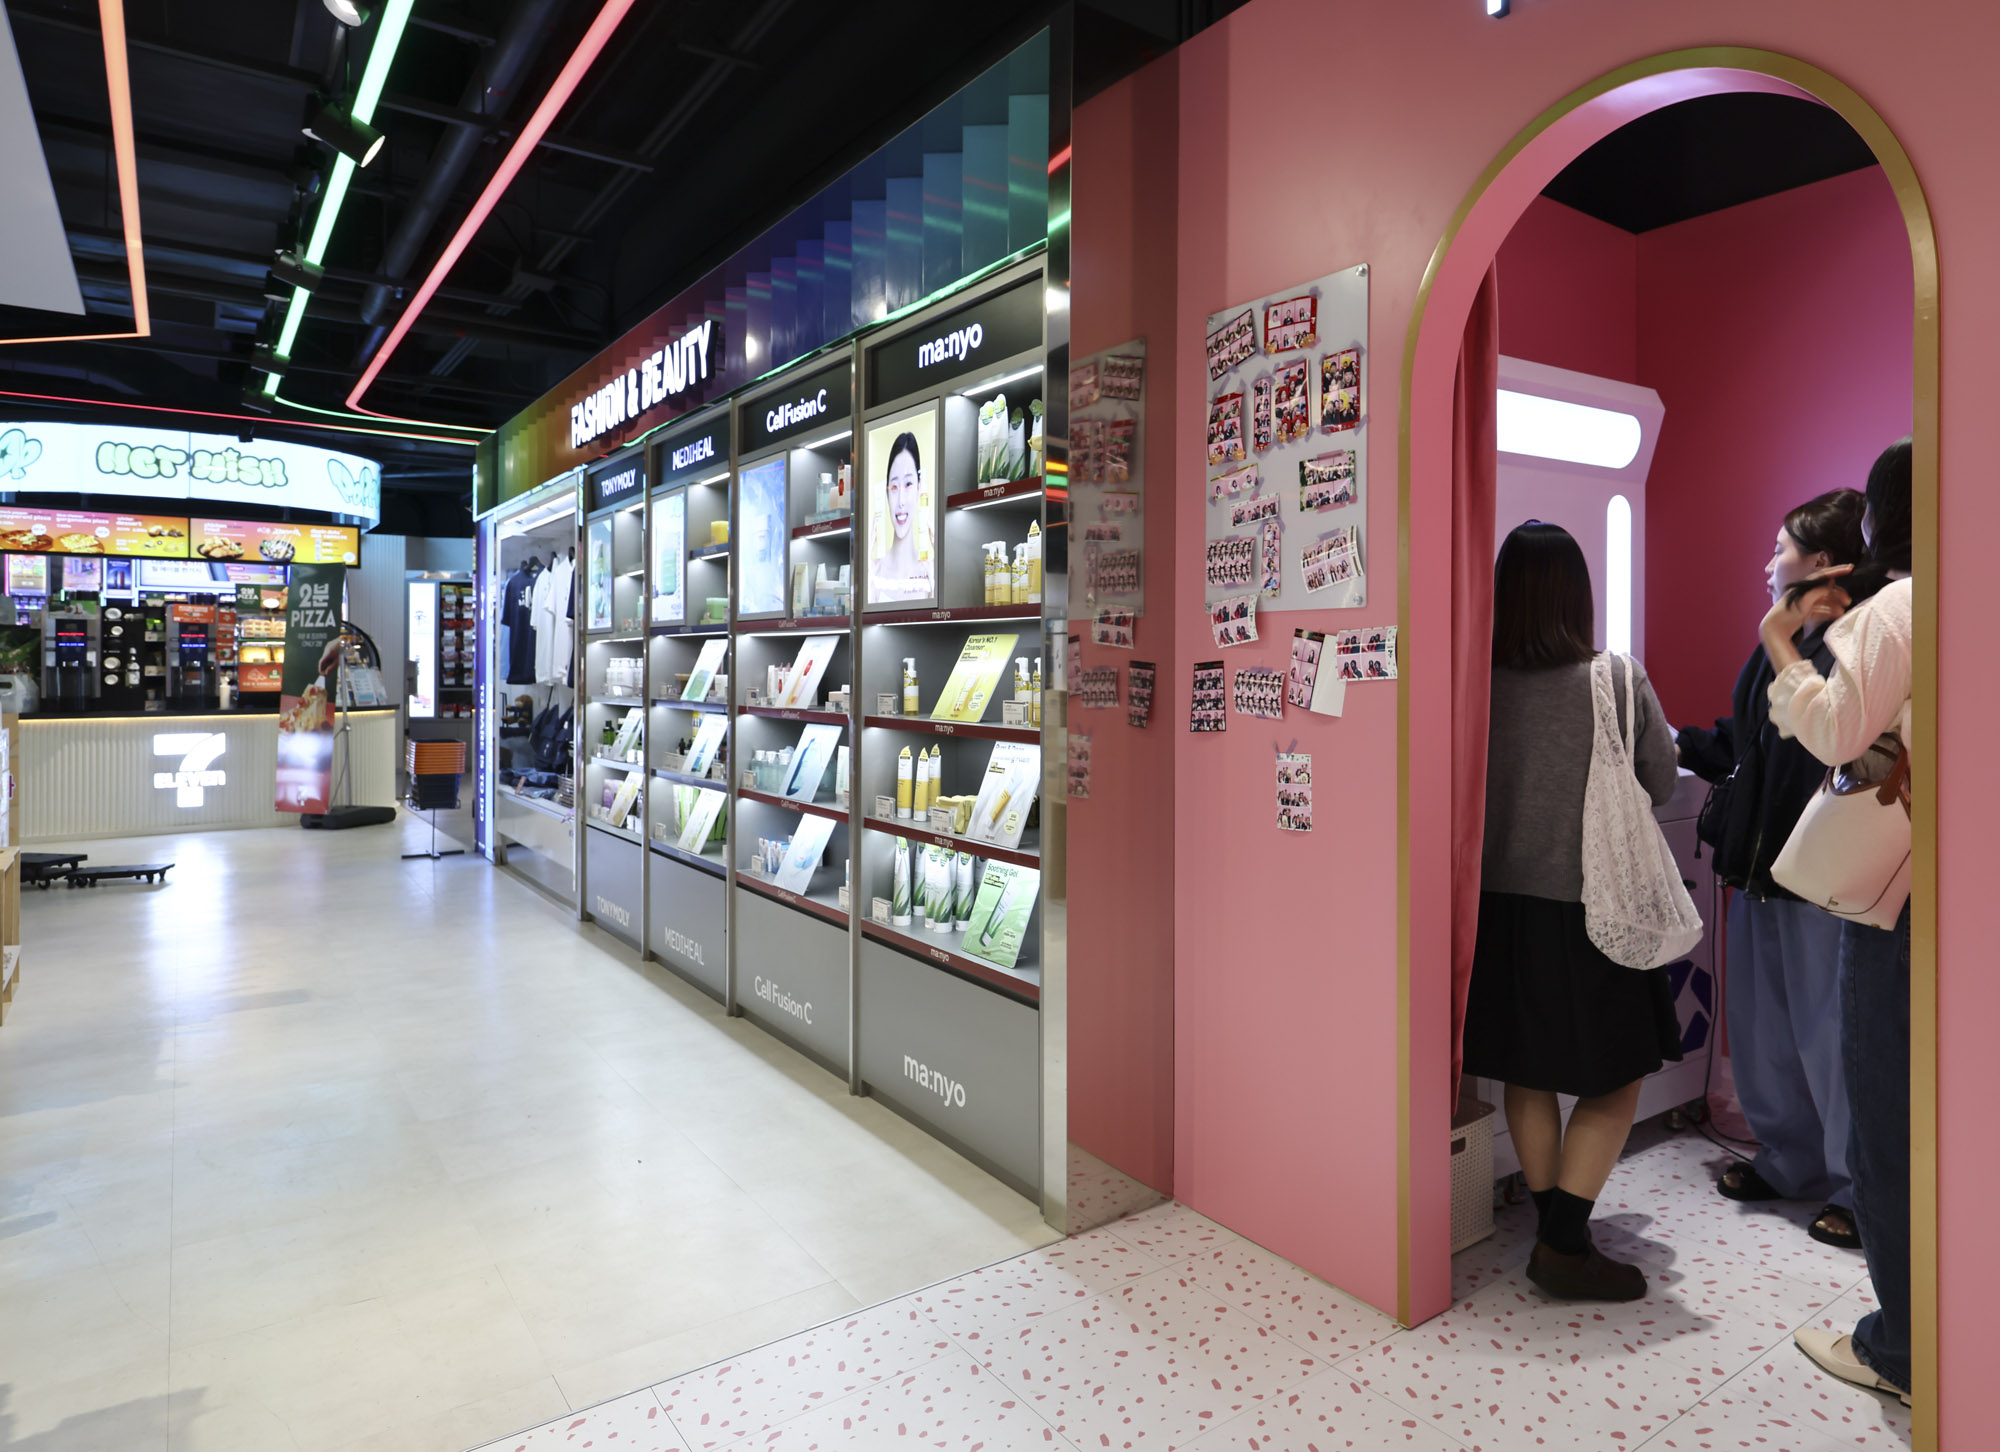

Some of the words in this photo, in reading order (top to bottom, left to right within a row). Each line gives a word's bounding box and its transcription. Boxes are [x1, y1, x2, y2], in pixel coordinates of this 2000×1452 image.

[918, 322, 983, 369] ma:nyo
[571, 374, 626, 449] FASHION
[627, 367, 639, 418] &
[641, 319, 712, 410] BEAUTY
[766, 401, 785, 433] Cell
[785, 396, 817, 427] Fusion
[817, 388, 827, 413] C
[96, 441, 188, 479] NCT
[672, 435, 714, 471] MEDIHEAL
[601, 468, 636, 497] TONYMOLY
[983, 484, 1005, 500] ma:nyo
[290, 609, 336, 628] PIZZA
[931, 610, 951, 621] ma:nyo
[934, 723, 954, 734] ma:nyo
[934, 835, 954, 848] ma:nyo
[987, 863, 1009, 877] Soothing
[596, 896, 630, 929] TONYMOLY
[664, 926, 704, 967] MEDIHEAL
[930, 947, 950, 962] ma:nyo
[754, 975, 773, 1003] Cell
[773, 983, 803, 1020] Fusion
[804, 1001, 812, 1025] C
[903, 1054, 966, 1108] ma:nyo
